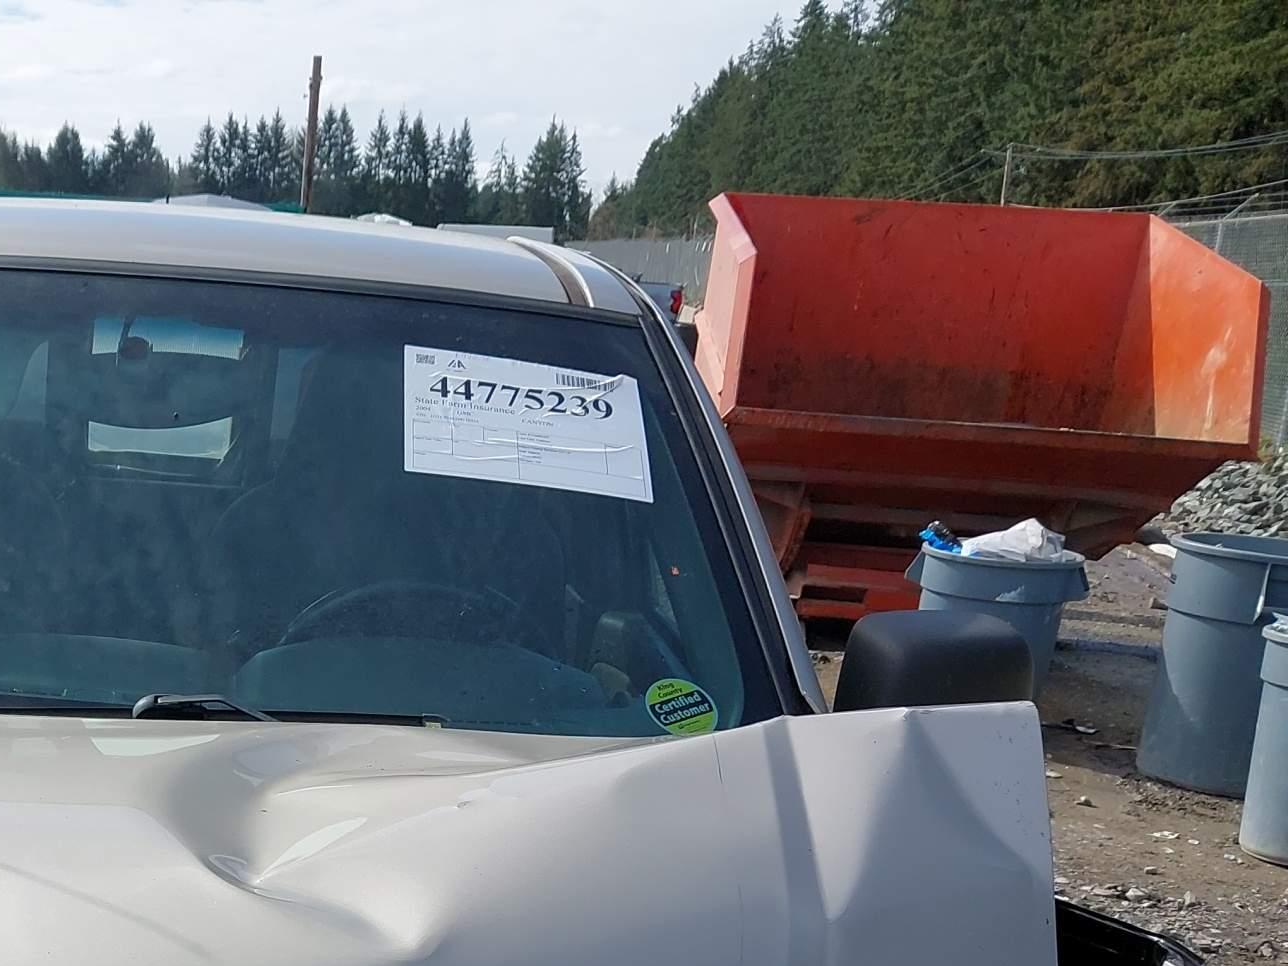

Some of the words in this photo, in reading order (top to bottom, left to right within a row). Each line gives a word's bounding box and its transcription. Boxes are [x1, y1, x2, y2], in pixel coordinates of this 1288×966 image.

[415, 396, 439, 405] State
[429, 375, 613, 420] 44775239
[656, 682, 675, 691] King
[657, 687, 683, 698] County
[654, 691, 702, 713] Certified
[660, 702, 710, 723] Customer
